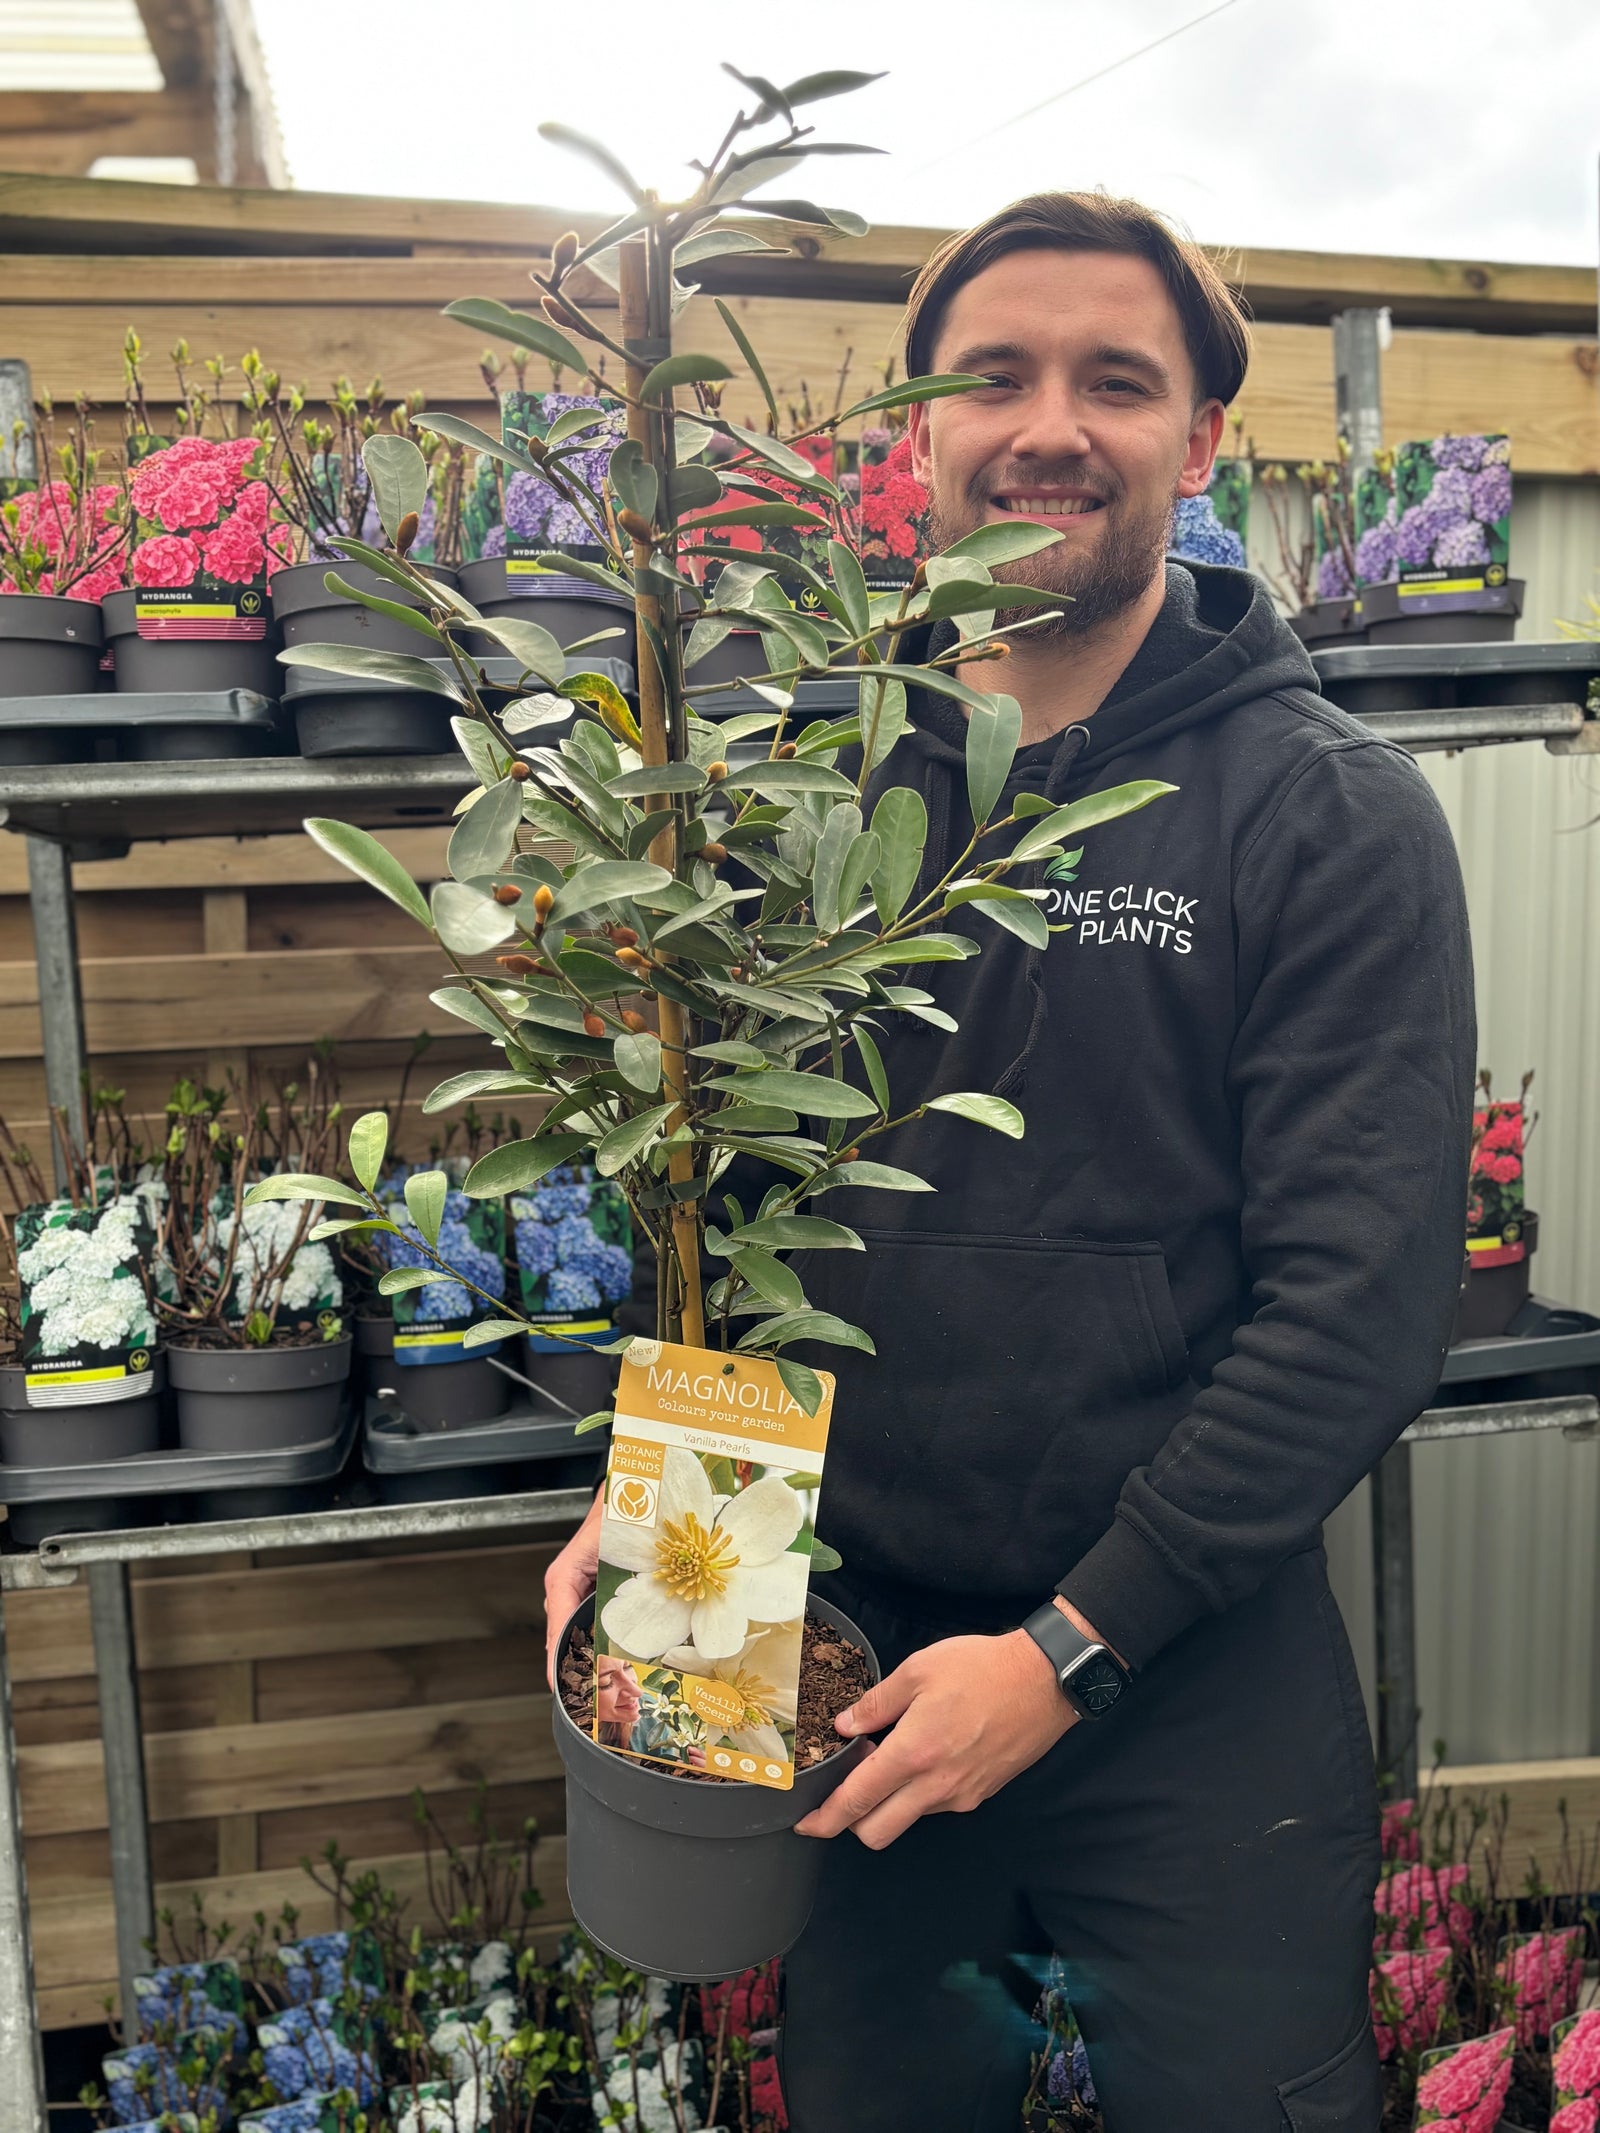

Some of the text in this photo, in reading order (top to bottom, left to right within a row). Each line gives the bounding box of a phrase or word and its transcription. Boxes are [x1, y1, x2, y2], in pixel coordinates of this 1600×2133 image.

[141, 592, 193, 601] HYDRANGEA
[1046, 884, 1199, 924] ONE CLICK
[1079, 916, 1193, 954] PLANTS
[628, 1344, 657, 1357] New!
[31, 1359, 83, 1371] HYDRANGEA
[646, 1365, 804, 1418] MAGNOLIA
[657, 1397, 785, 1433] Colours your garden
[615, 1443, 663, 1461] BOTANIC
[683, 1433, 751, 1455] Vanilla Pearls
[614, 1457, 661, 1474] FRIENDS
[694, 1685, 746, 1716] Vanilla
[696, 1701, 733, 1724] Scent
